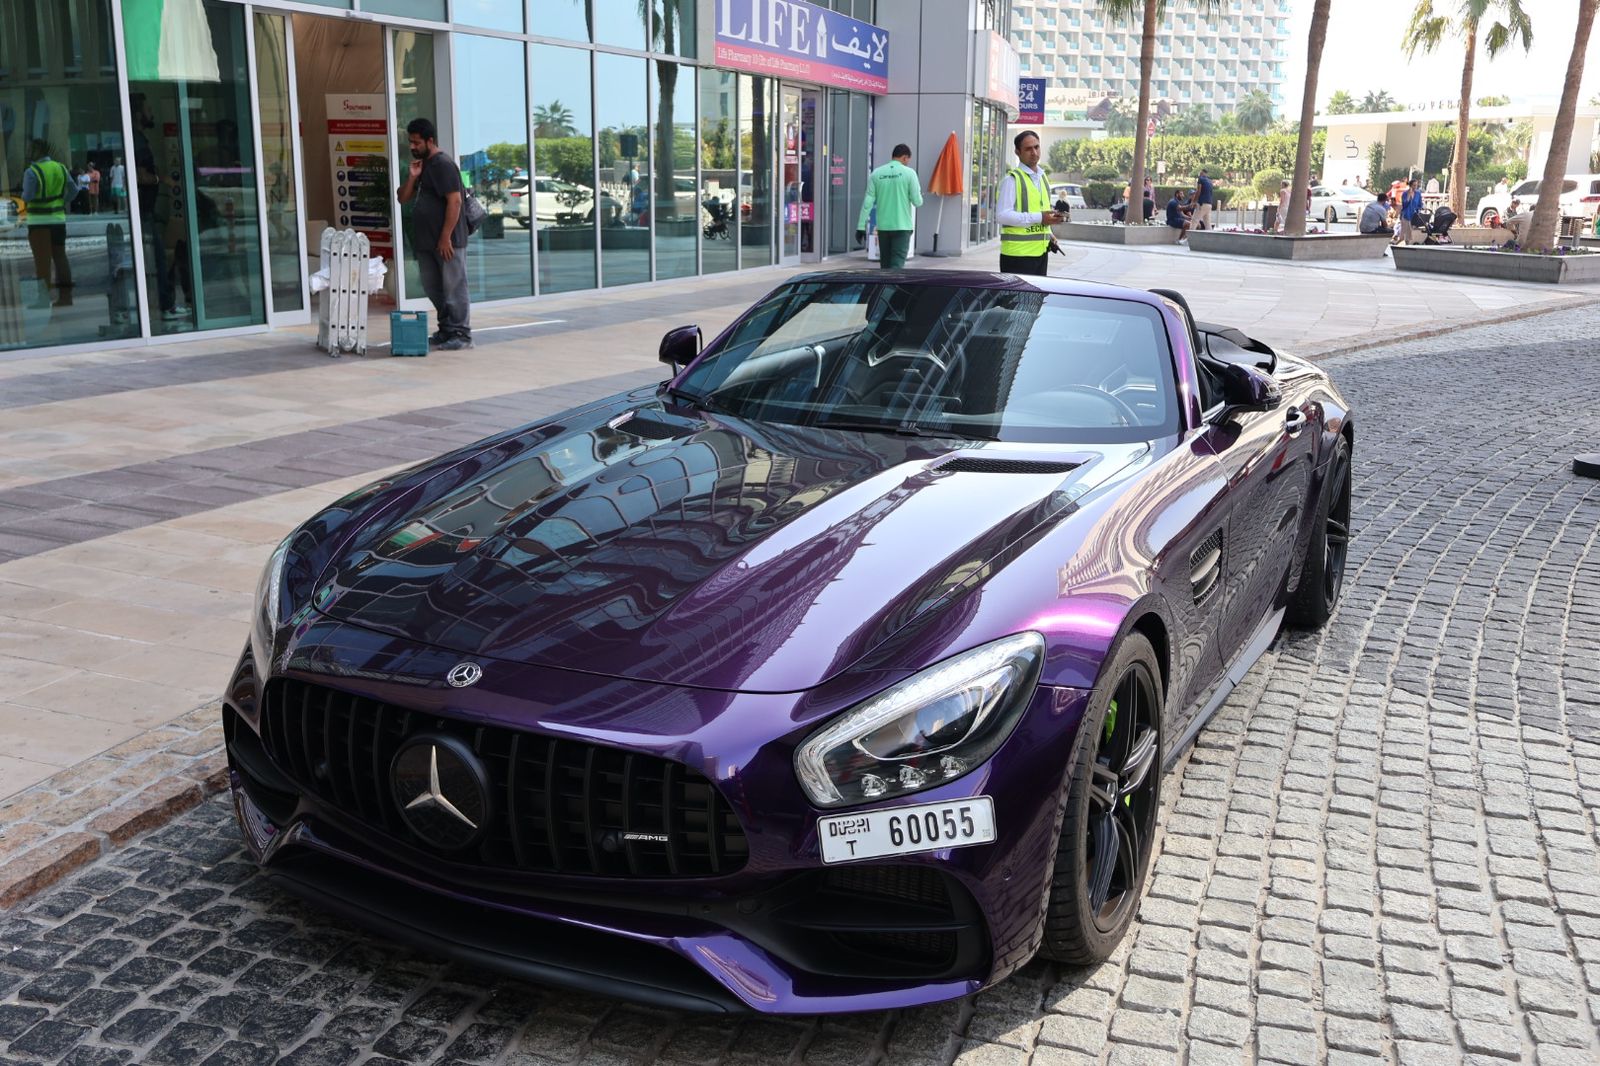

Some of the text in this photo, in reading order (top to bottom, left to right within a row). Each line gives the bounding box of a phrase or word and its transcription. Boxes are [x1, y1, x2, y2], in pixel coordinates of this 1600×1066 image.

[717, 0, 810, 55] LIFE
[717, 47, 727, 59] Life
[728, 48, 751, 66] Pharmacy
[831, 26, 888, 70] لايف
[1019, 90, 1035, 103] 24
[1020, 83, 1039, 91] PEN
[889, 806, 975, 847] 60055
[846, 840, 858, 856] T
